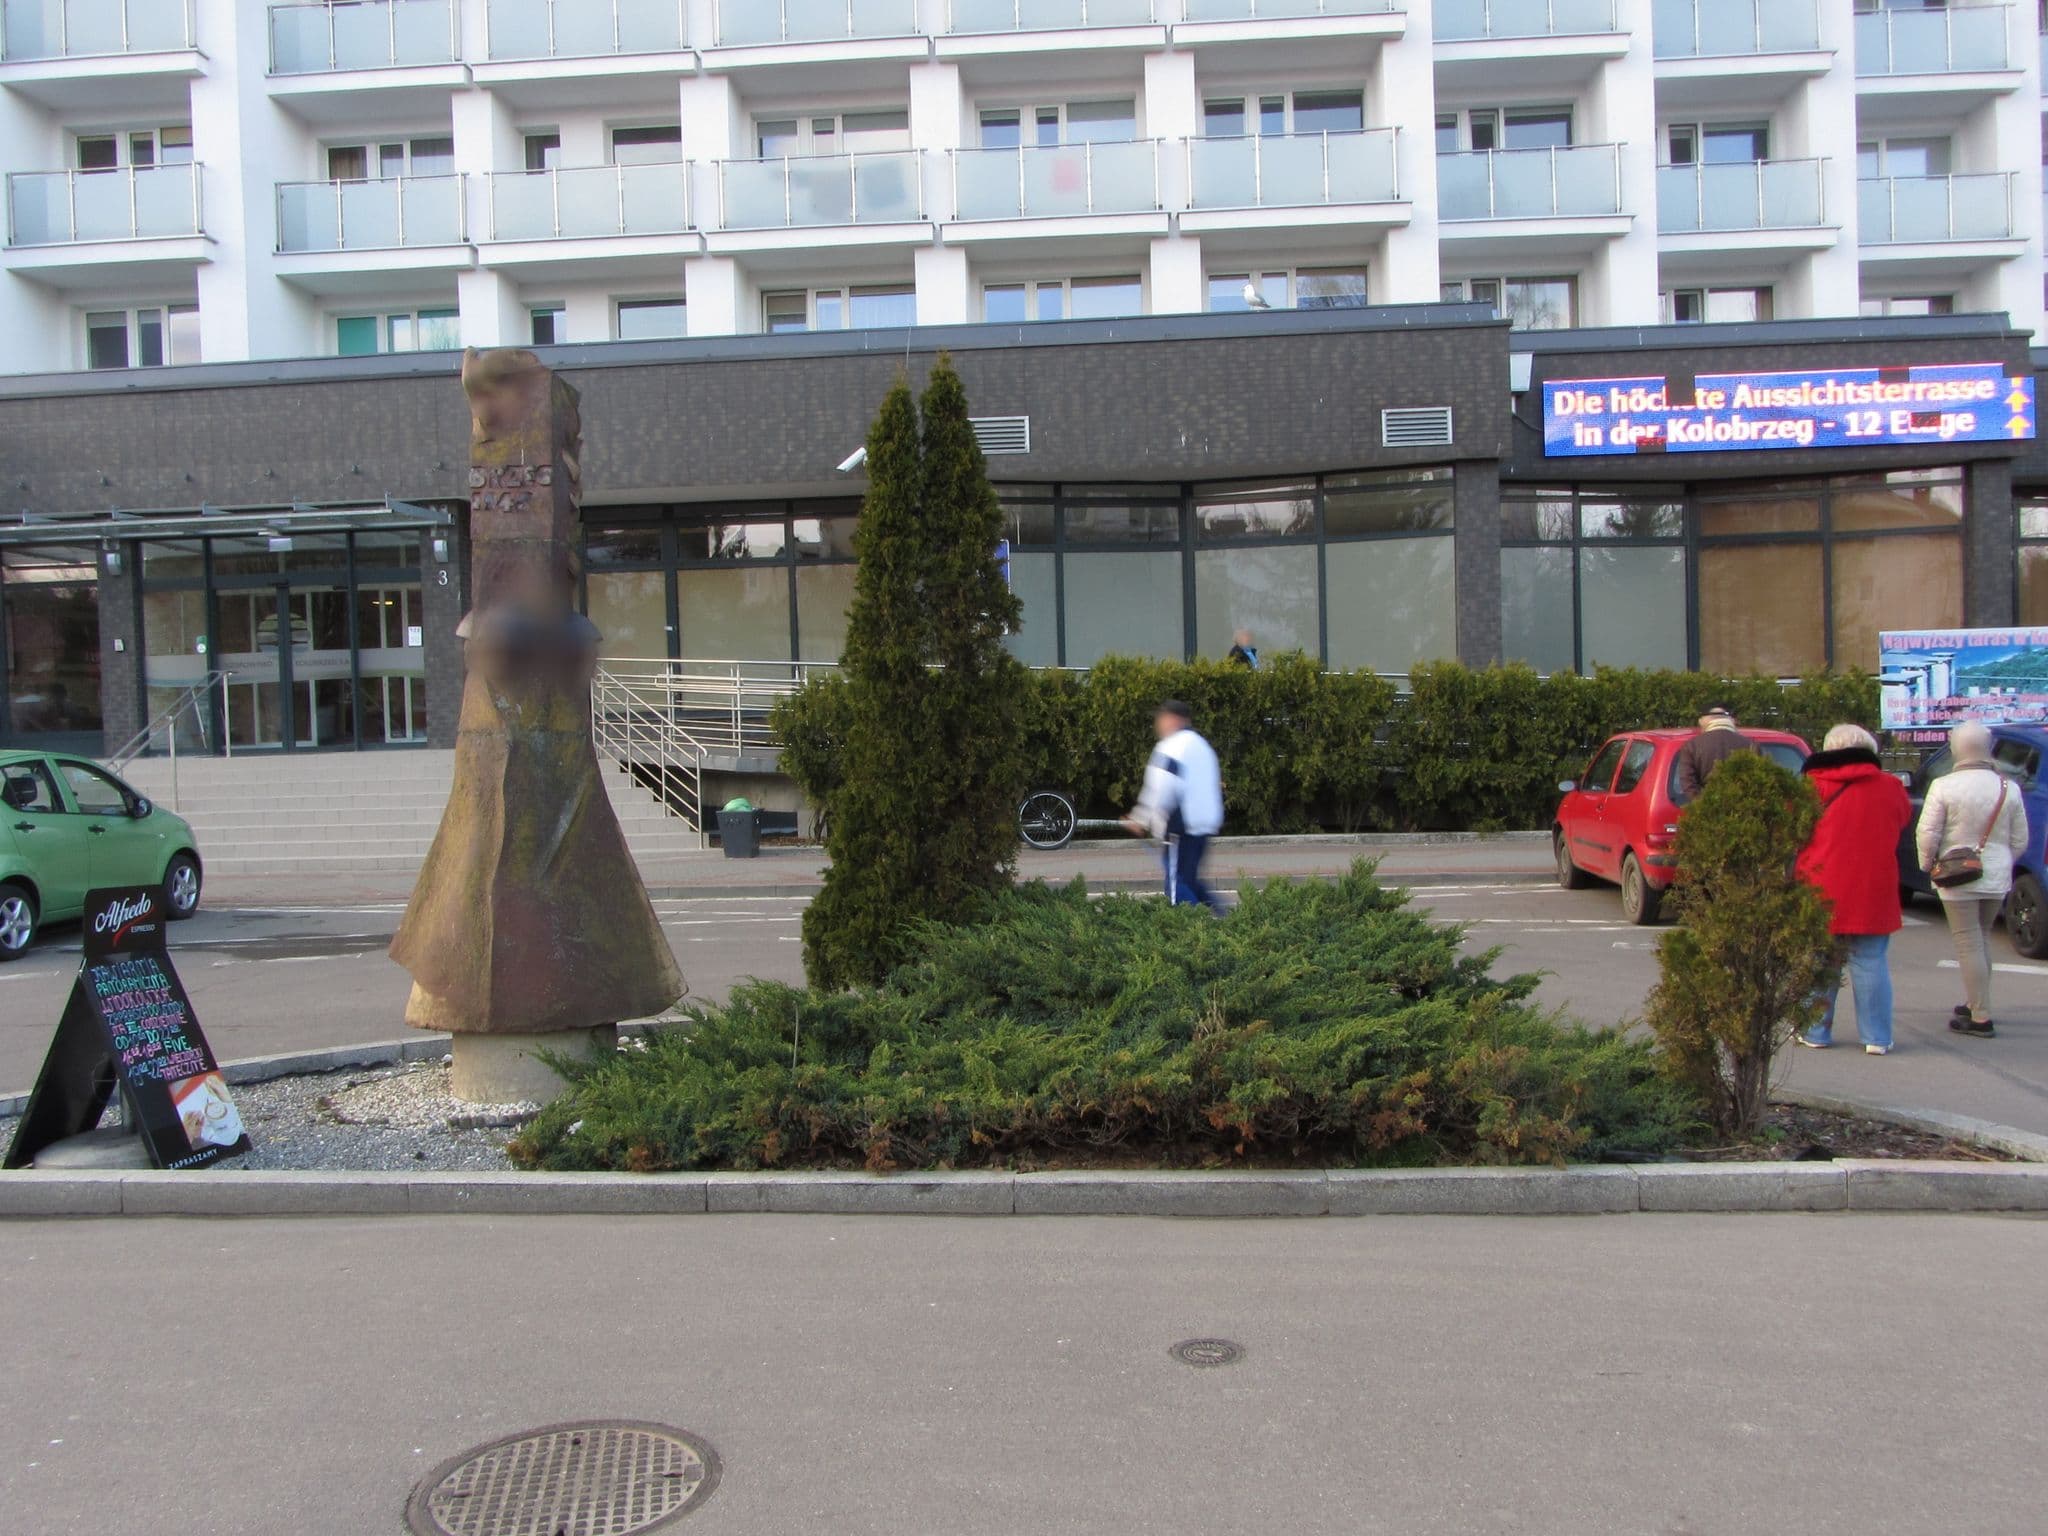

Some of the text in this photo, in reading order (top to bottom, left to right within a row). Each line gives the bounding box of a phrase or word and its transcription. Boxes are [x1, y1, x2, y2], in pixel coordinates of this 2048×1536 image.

[1554, 390, 1603, 416] Die
[1732, 379, 1994, 409] Aussichtsterrasse
[1667, 414, 1815, 445] Kolobrzeg
[1844, 411, 1882, 436] 12
[1890, 410, 1976, 439] Ege
[438, 569, 448, 586] 3
[1913, 730, 1946, 742] laden
[95, 893, 152, 932] Alfredo
[163, 1036, 192, 1054] FIVE
[168, 1147, 218, 1169] ZAPRASZAMY
